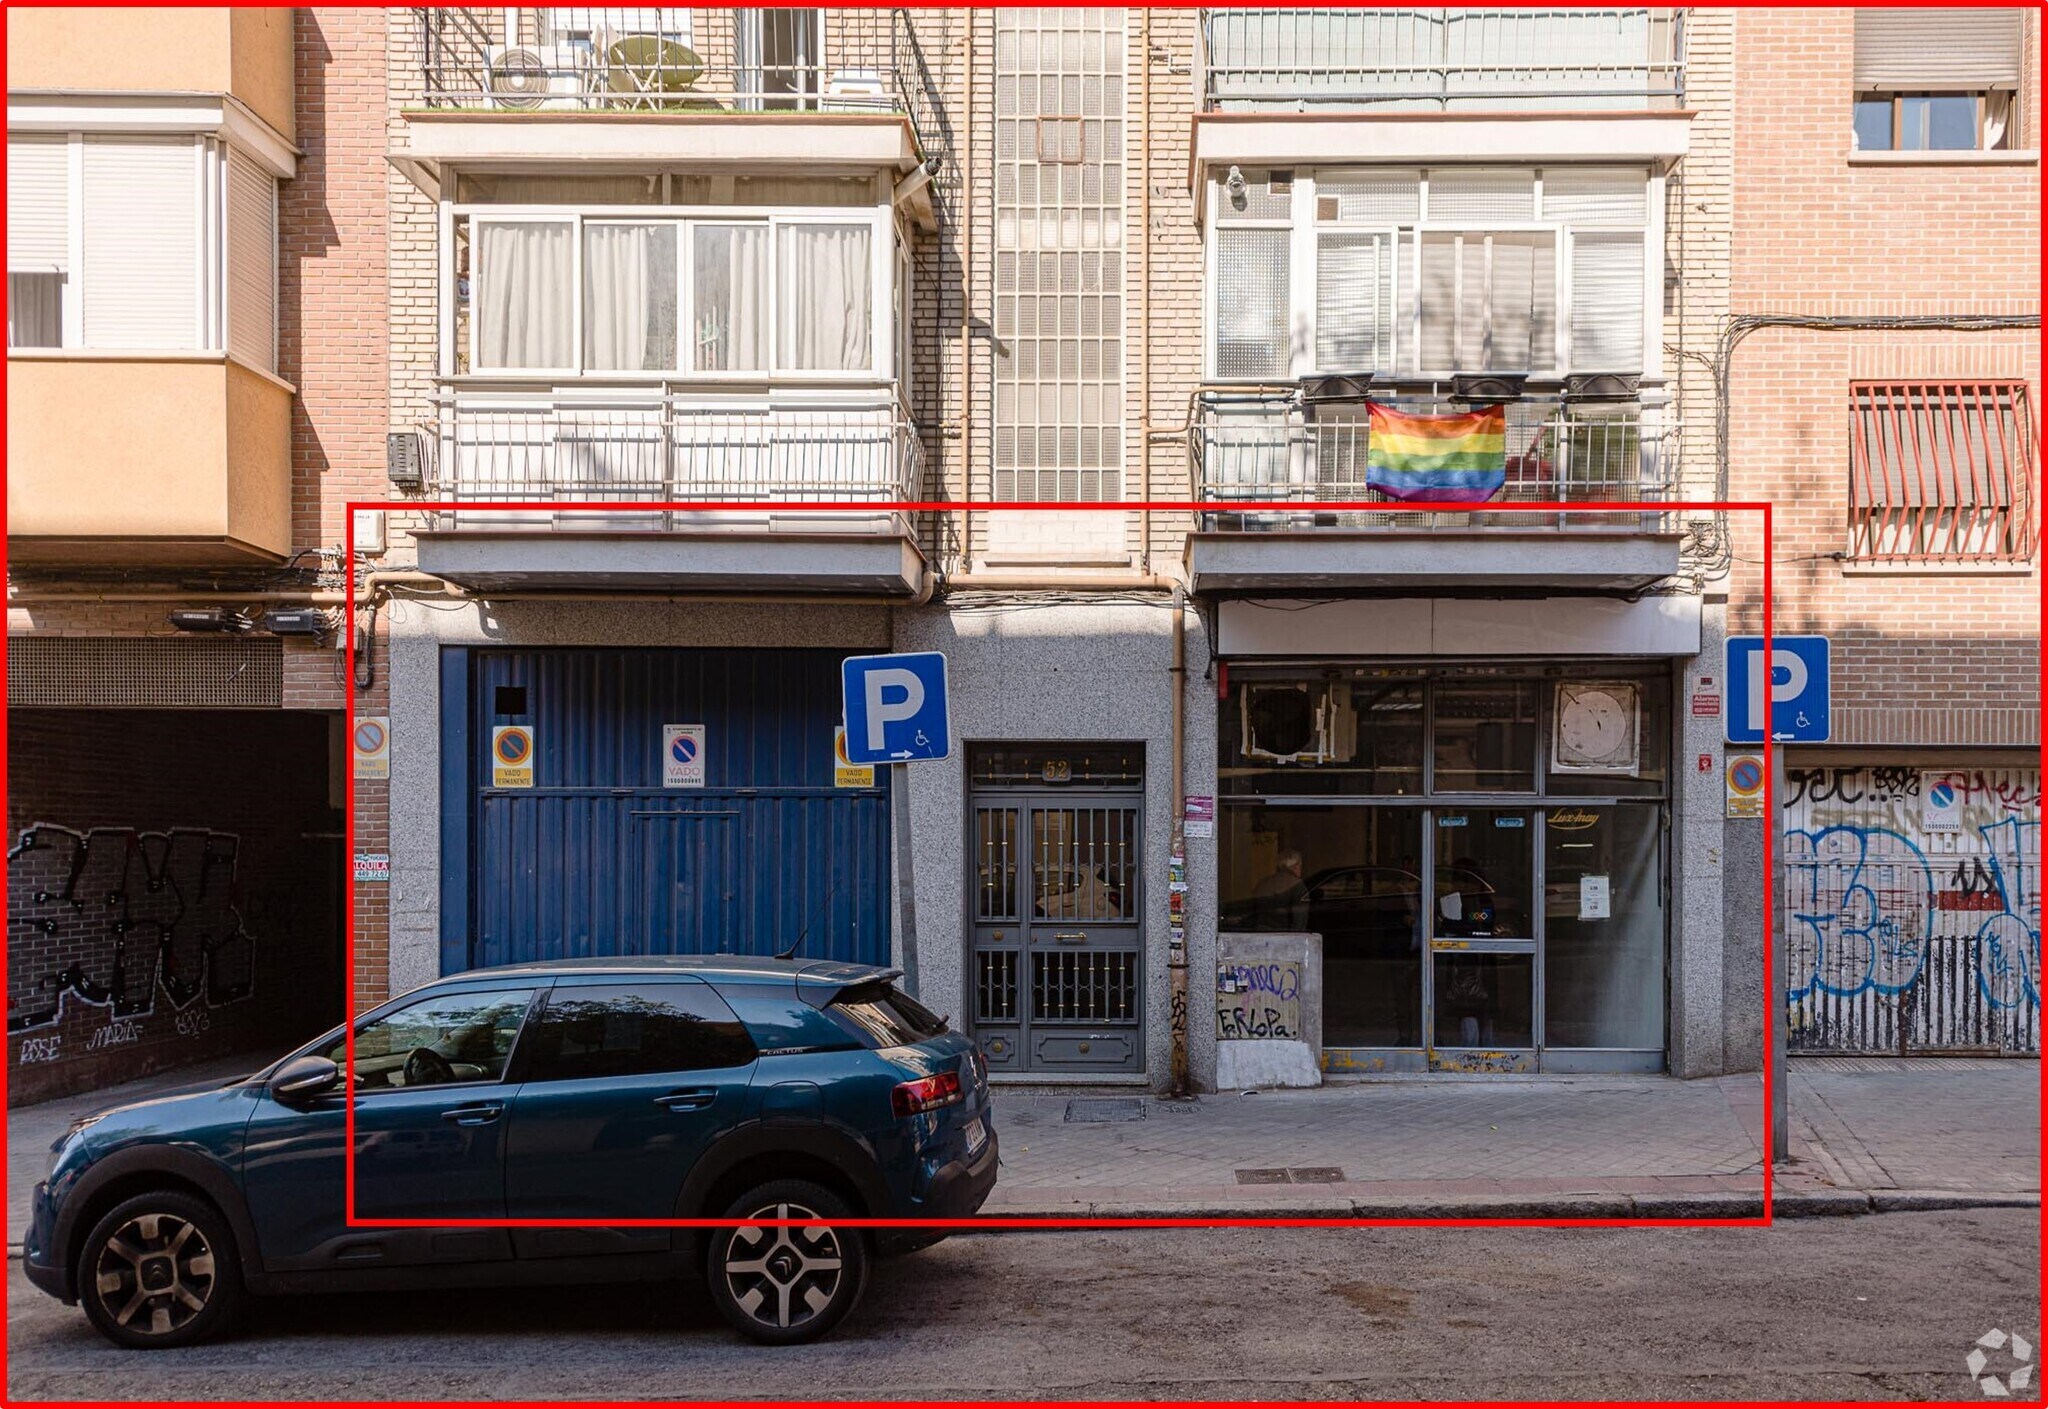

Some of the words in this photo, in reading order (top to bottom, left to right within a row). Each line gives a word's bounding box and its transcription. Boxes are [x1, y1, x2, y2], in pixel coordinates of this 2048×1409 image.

[1747, 650, 1808, 730] P
[864, 668, 925, 751] P
[503, 769, 522, 777] VADO
[668, 766, 701, 776] VADO
[845, 769, 863, 777] VADO
[1046, 760, 1068, 778] 52
[495, 778, 531, 786] PERMANENTE
[837, 777, 873, 786] PERMANENTE
